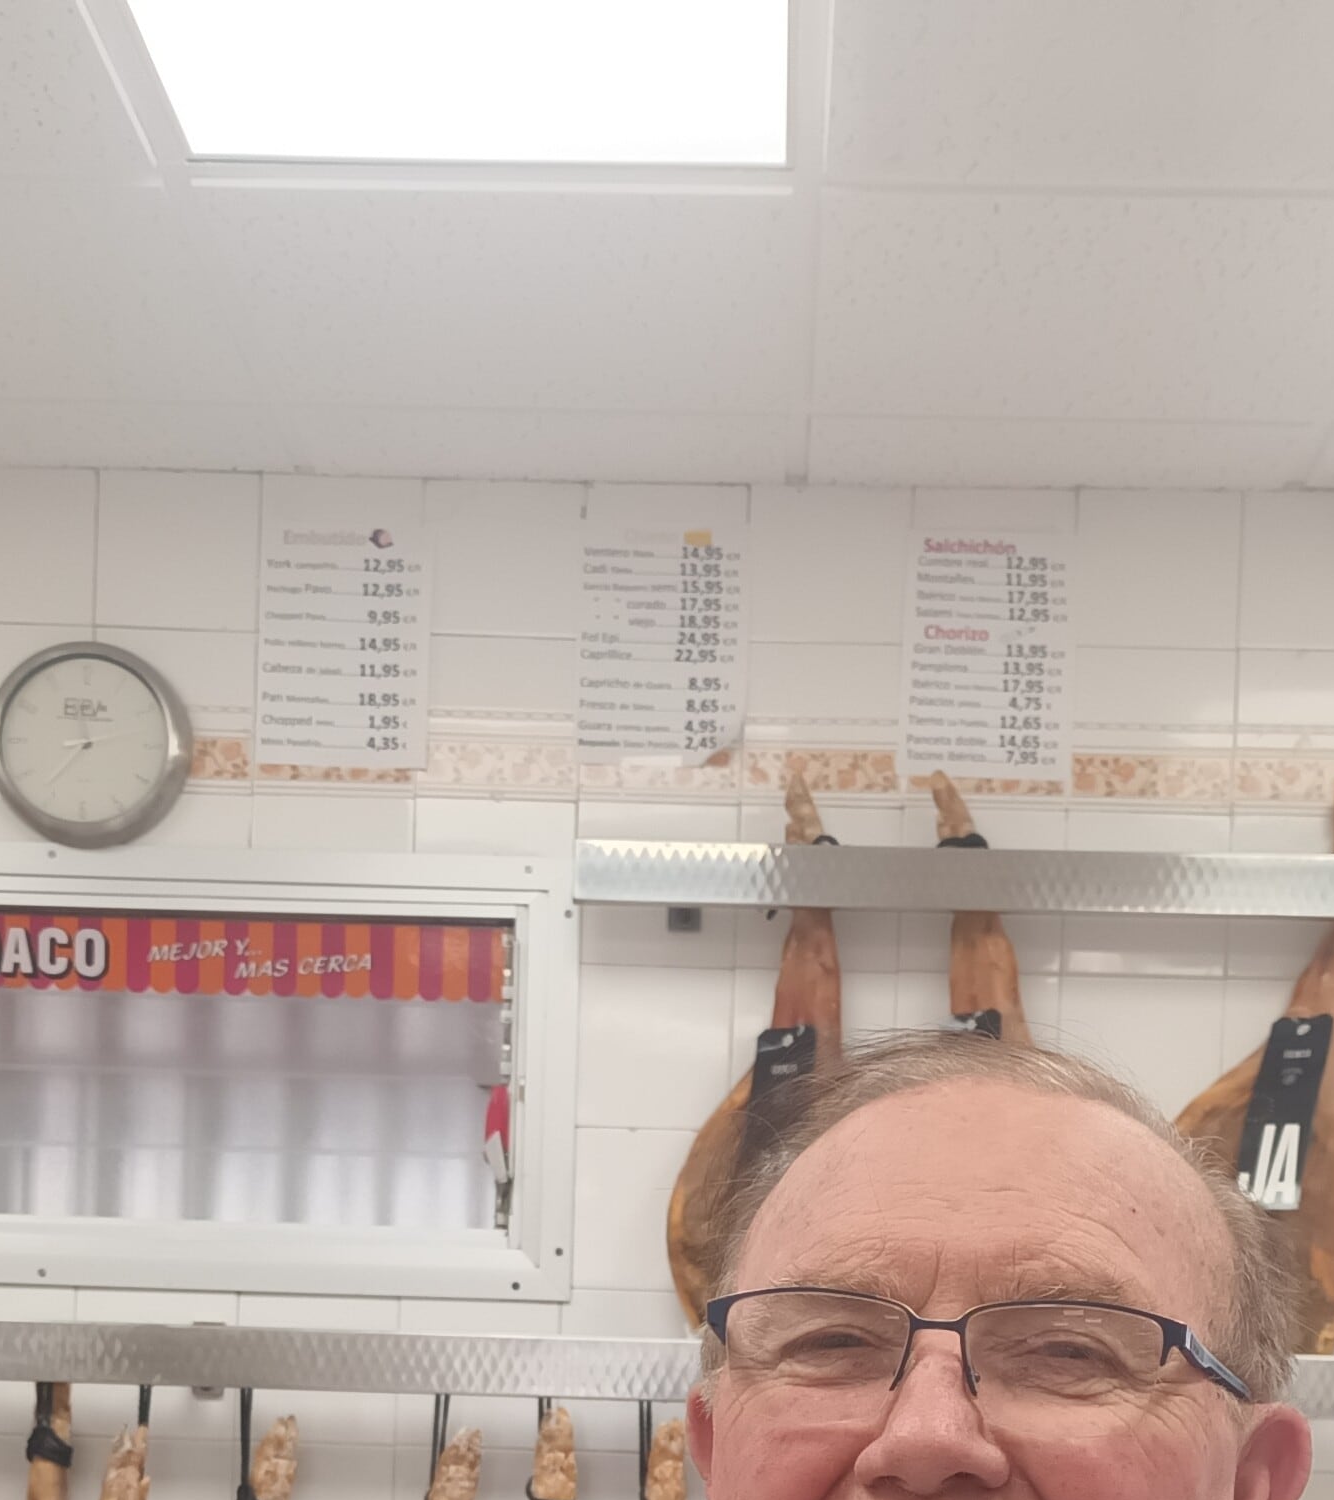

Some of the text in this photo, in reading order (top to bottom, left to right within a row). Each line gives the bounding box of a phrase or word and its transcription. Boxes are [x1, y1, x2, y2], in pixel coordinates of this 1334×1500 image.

[682, 546, 724, 561] 14,95
[923, 537, 1017, 554] Salchichón
[363, 558, 405, 574] 12,95
[680, 562, 721, 578] 13,95
[1006, 556, 1048, 571] 12,95
[682, 580, 724, 596] 15,95
[1006, 573, 1048, 587] 11,95
[362, 583, 404, 599] 12,95
[1007, 591, 1049, 606] 17,95
[680, 597, 722, 613] 17,95
[367, 610, 401, 626] 9,95
[679, 615, 721, 630] 18,95
[1009, 607, 1050, 622] 12,95
[677, 632, 720, 647] 24,95
[924, 624, 989, 641] Chorizo
[359, 637, 401, 653] 14,95
[1006, 644, 1048, 659] 13,95
[675, 649, 717, 664] 22,95
[359, 663, 401, 679] 11,95
[1003, 661, 1044, 676] 13,95
[688, 677, 721, 693] 8,95
[1003, 679, 1044, 694] 17,95
[359, 692, 400, 708] 18,95
[685, 699, 719, 714] 8,65
[1008, 697, 1042, 712] 4,75
[368, 715, 400, 731] 1,95
[684, 719, 717, 735] 4,95
[1000, 715, 1042, 730] 12,65
[367, 736, 399, 752] 4,35
[684, 736, 717, 752] 2,45
[999, 735, 1040, 750] 14,65
[1005, 750, 1038, 766] 7,95
[148, 938, 232, 963] MEJOR
[234, 953, 373, 980] MAS CERCA
[1238, 1123, 1301, 1206] JA
